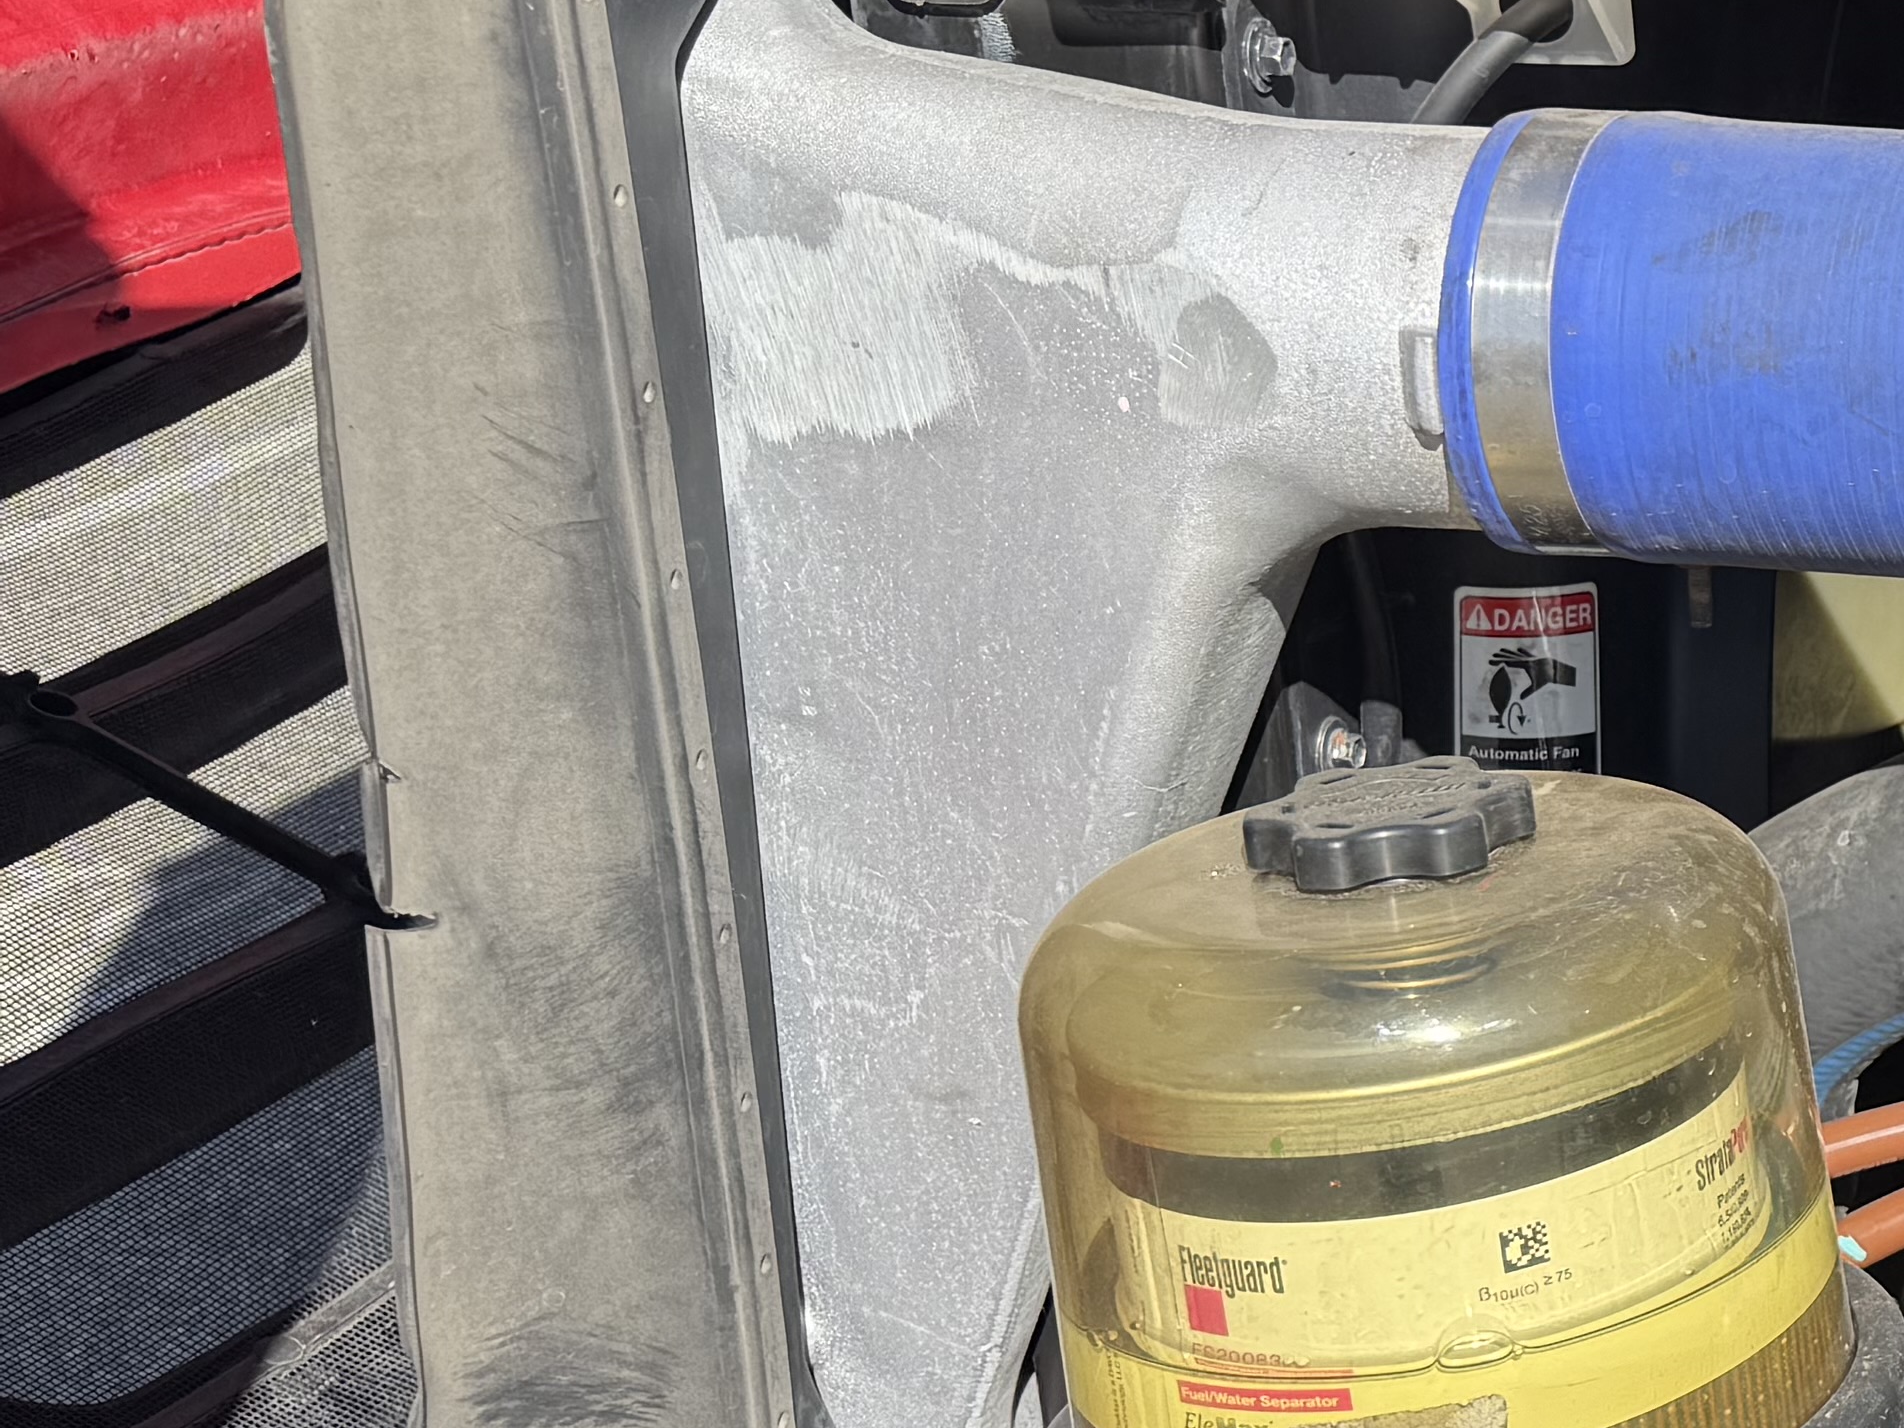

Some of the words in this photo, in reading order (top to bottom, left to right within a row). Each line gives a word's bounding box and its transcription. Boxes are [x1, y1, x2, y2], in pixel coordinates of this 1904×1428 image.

[1494, 603, 1592, 631] DANGER
[1469, 746, 1549, 761] Automatic
[1553, 746, 1579, 757] Fan
[1178, 1244, 1287, 1299] Fleetguard
[1556, 1268, 1572, 1282] 75
[1181, 1386, 1256, 1408] Fuel/Water
[1260, 1394, 1339, 1410] Separator
